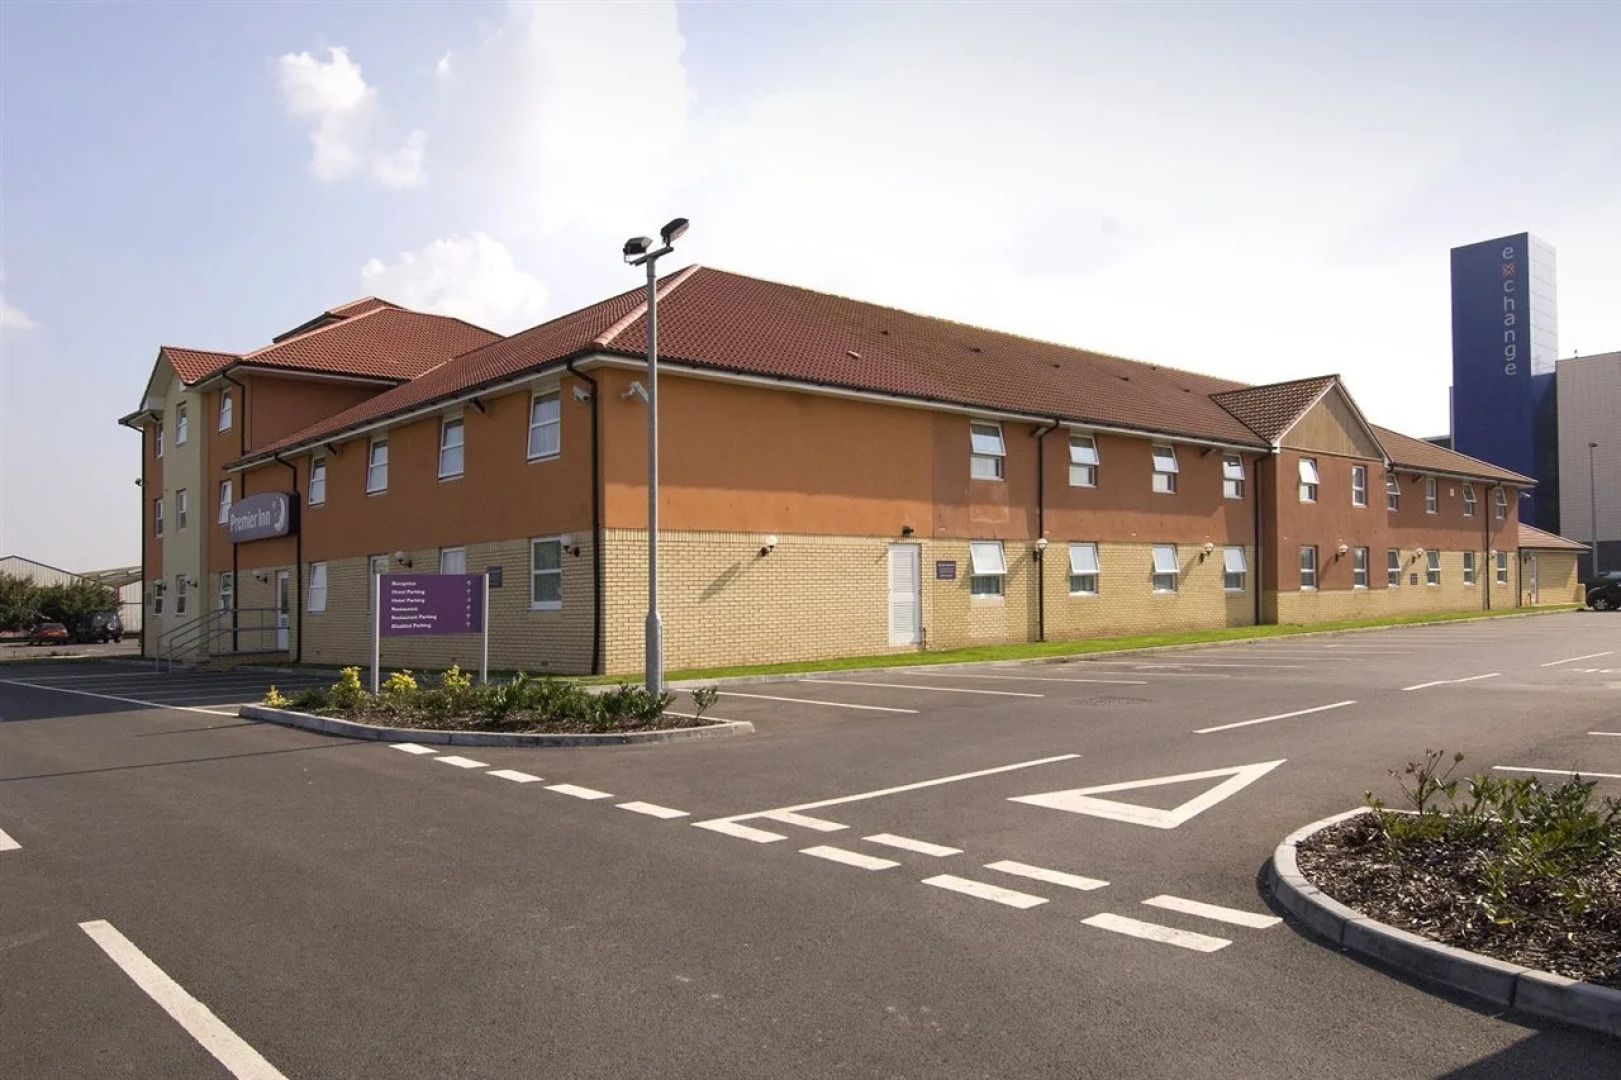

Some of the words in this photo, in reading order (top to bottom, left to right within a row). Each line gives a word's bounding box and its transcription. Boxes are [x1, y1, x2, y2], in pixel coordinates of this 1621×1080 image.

[1502, 246, 1517, 376] exchange
[230, 511, 257, 532] Premier
[258, 508, 271, 527] Inn
